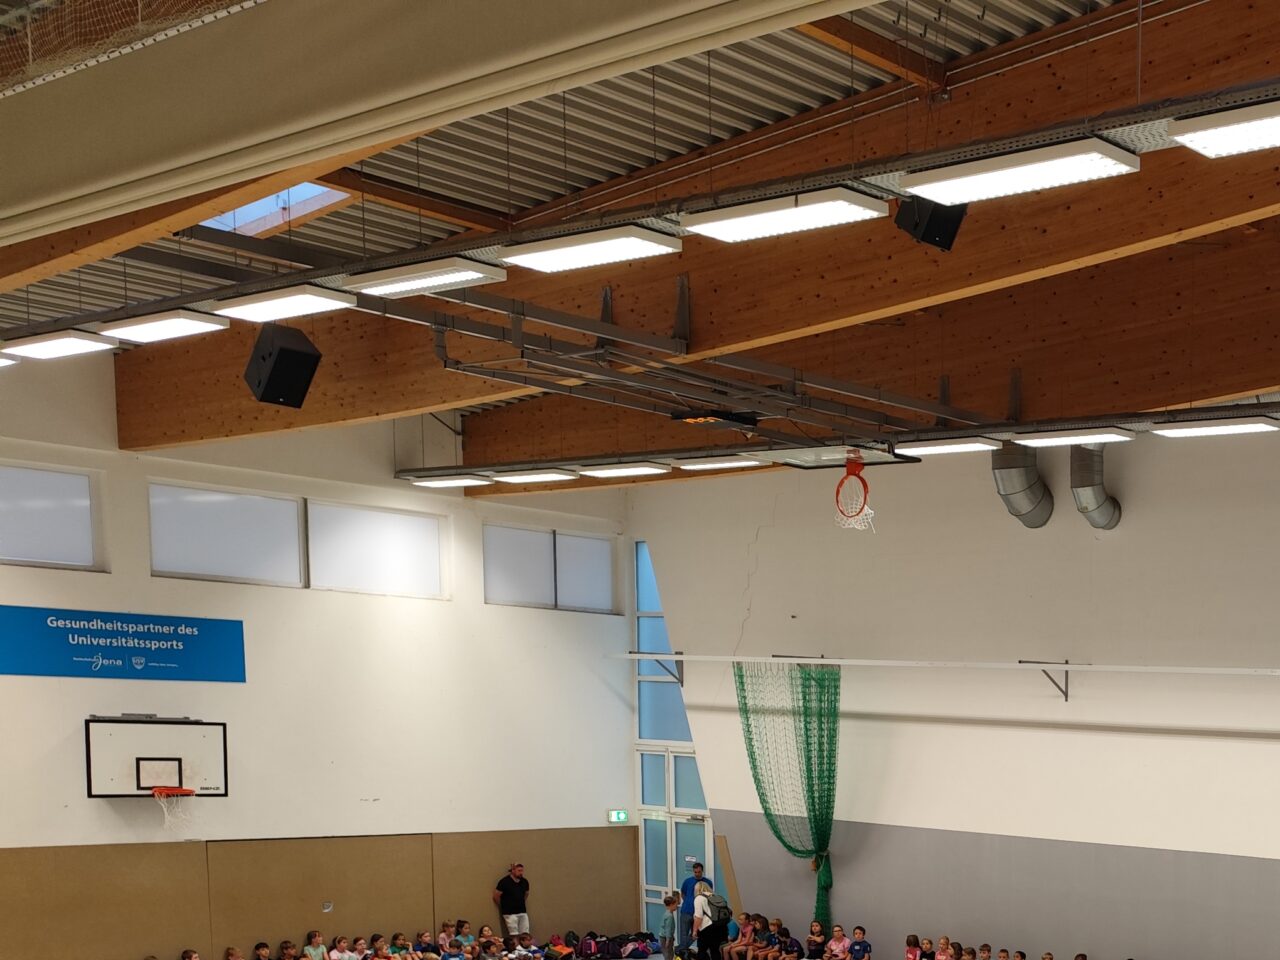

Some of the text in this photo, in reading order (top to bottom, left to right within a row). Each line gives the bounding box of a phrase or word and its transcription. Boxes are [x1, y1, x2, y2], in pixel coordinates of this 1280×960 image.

[47, 616, 199, 635] Gesundheitspartner des
[68, 633, 184, 650] Universitätssports
